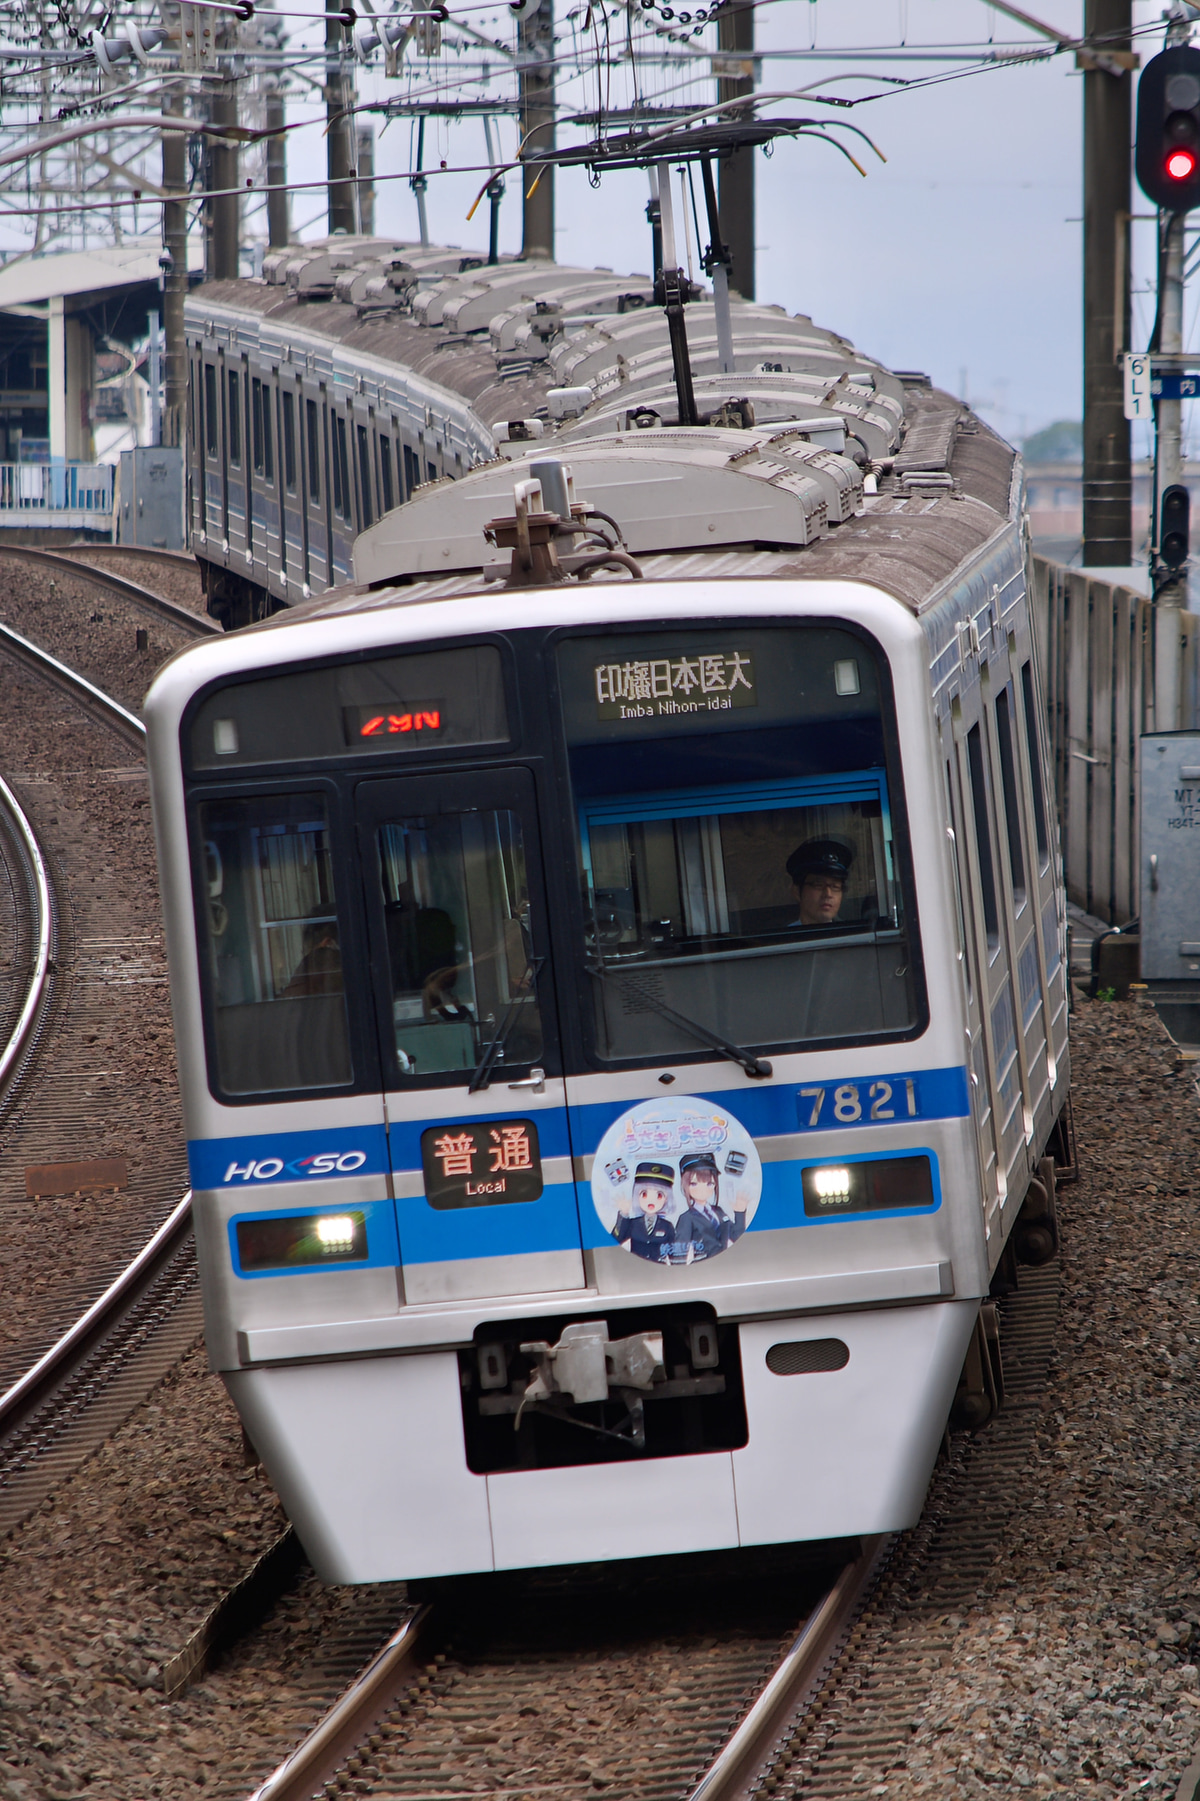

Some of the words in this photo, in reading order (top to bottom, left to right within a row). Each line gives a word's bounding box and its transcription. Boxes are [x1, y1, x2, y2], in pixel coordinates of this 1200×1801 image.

[595, 651, 753, 704] 印旛日本医大
[620, 704, 654, 719] Imba
[659, 695, 732, 715] Nihon-idai
[800, 1078, 917, 1127] 7821
[433, 1126, 534, 1177] 普通
[466, 1178, 506, 1195] Local
